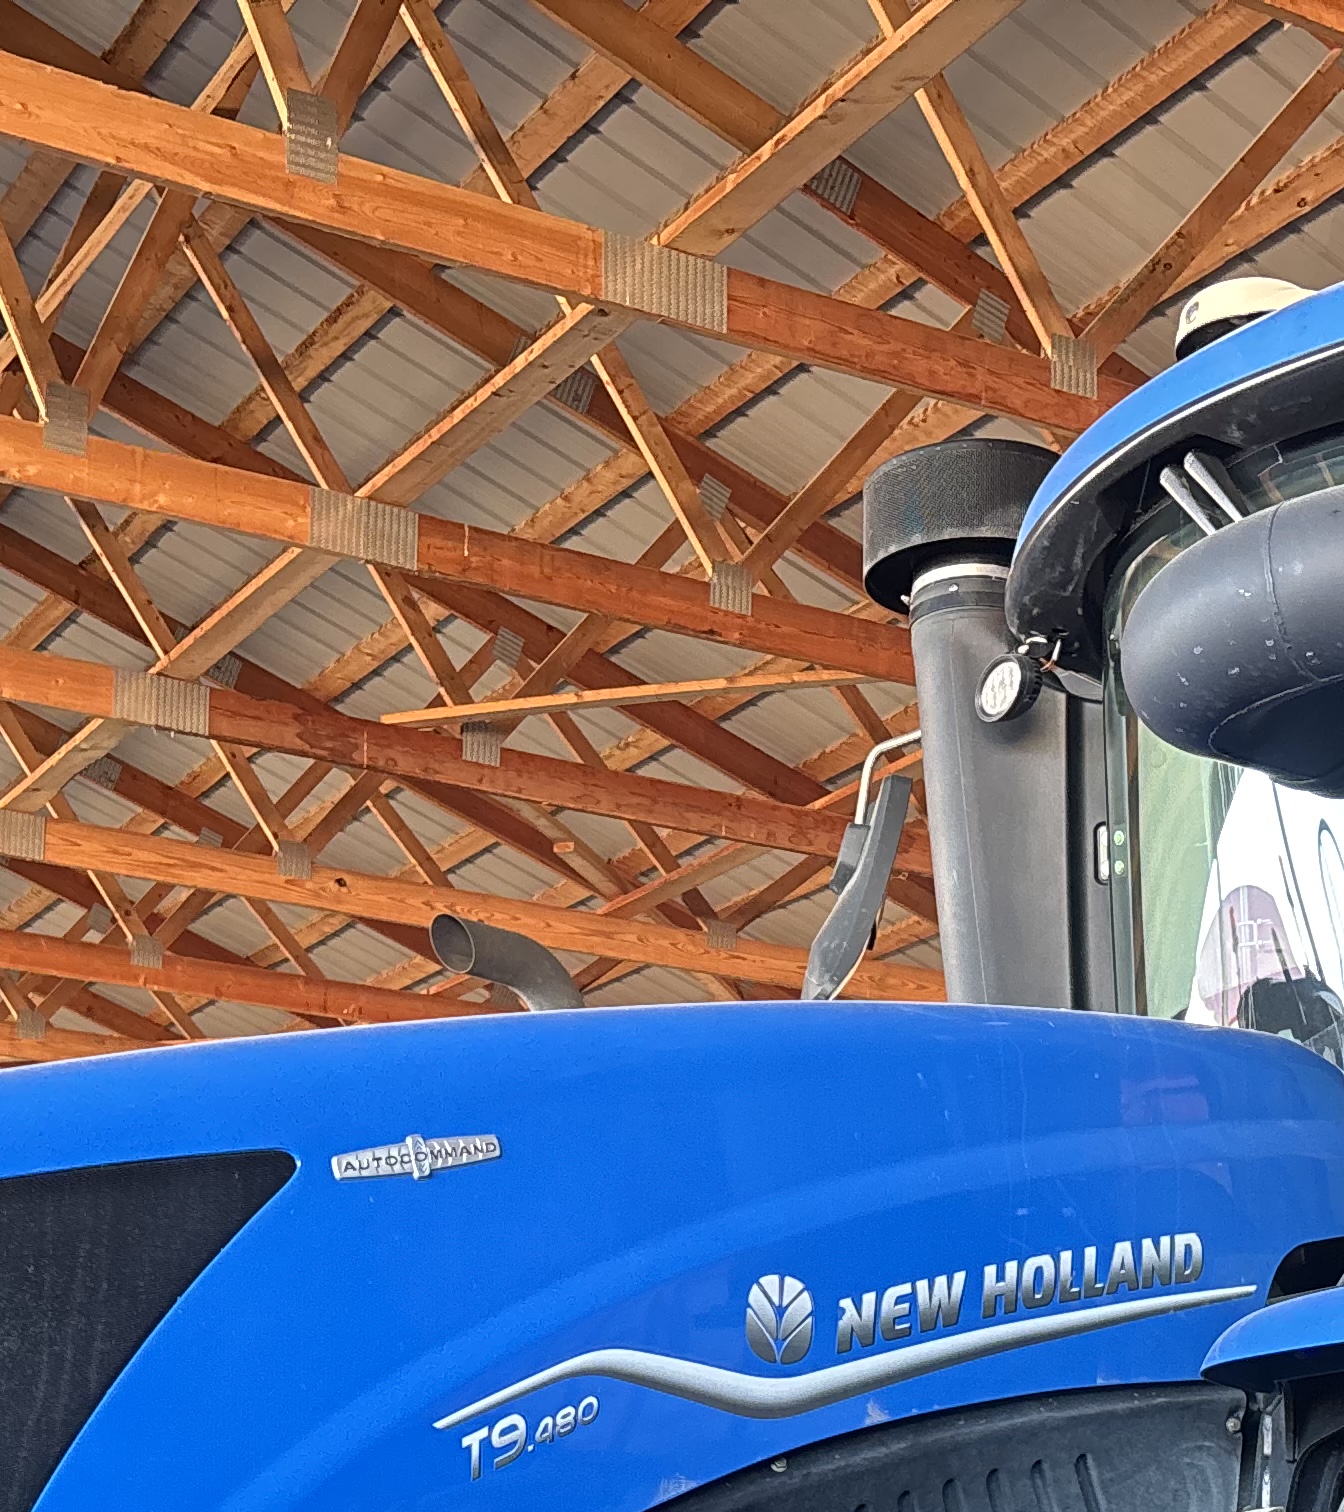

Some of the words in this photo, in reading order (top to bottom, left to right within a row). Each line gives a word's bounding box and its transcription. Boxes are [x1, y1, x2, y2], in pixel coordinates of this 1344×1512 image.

[342, 1141, 497, 1173] AUTOCOMMAND
[836, 1269, 967, 1354] NEW
[981, 1232, 1205, 1319] HOLLAND
[461, 1395, 600, 1482] T9.480
